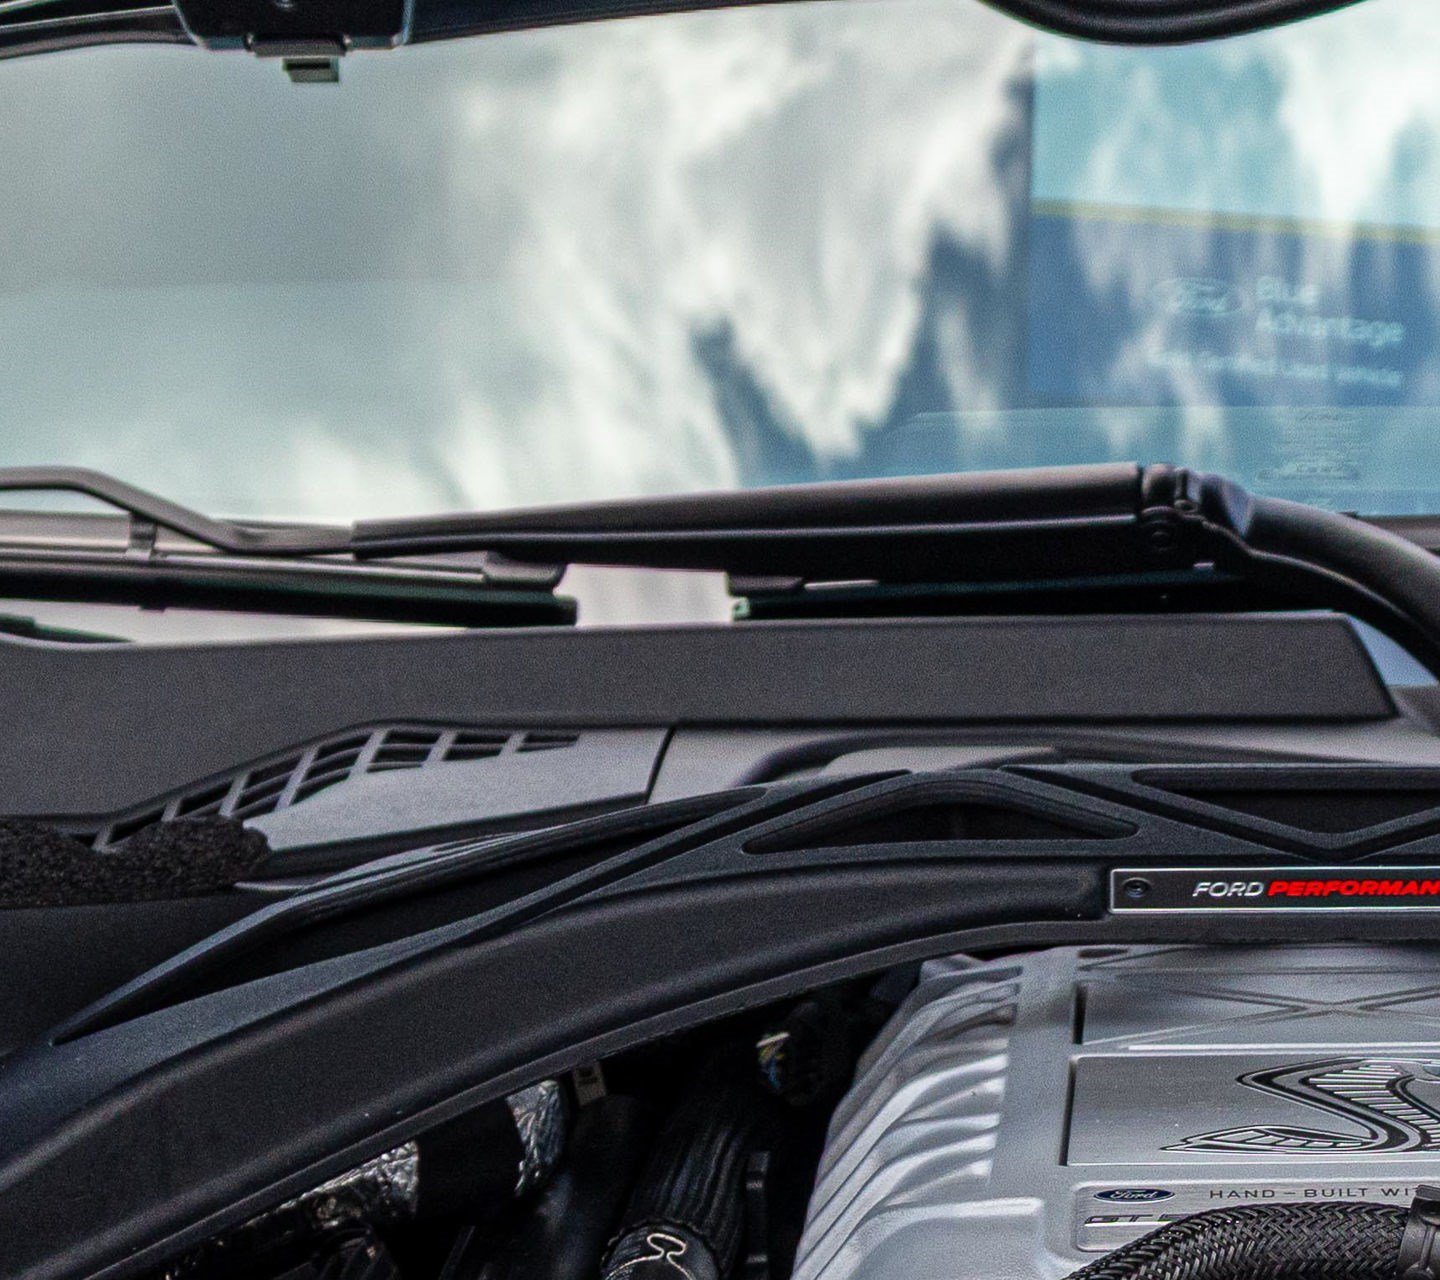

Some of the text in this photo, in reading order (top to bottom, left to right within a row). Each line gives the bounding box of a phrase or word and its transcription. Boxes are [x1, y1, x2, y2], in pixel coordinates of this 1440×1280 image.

[1192, 881, 1264, 897] FORD
[1209, 1188, 1275, 1199] HAND
[1303, 1187, 1369, 1199] BUILT
